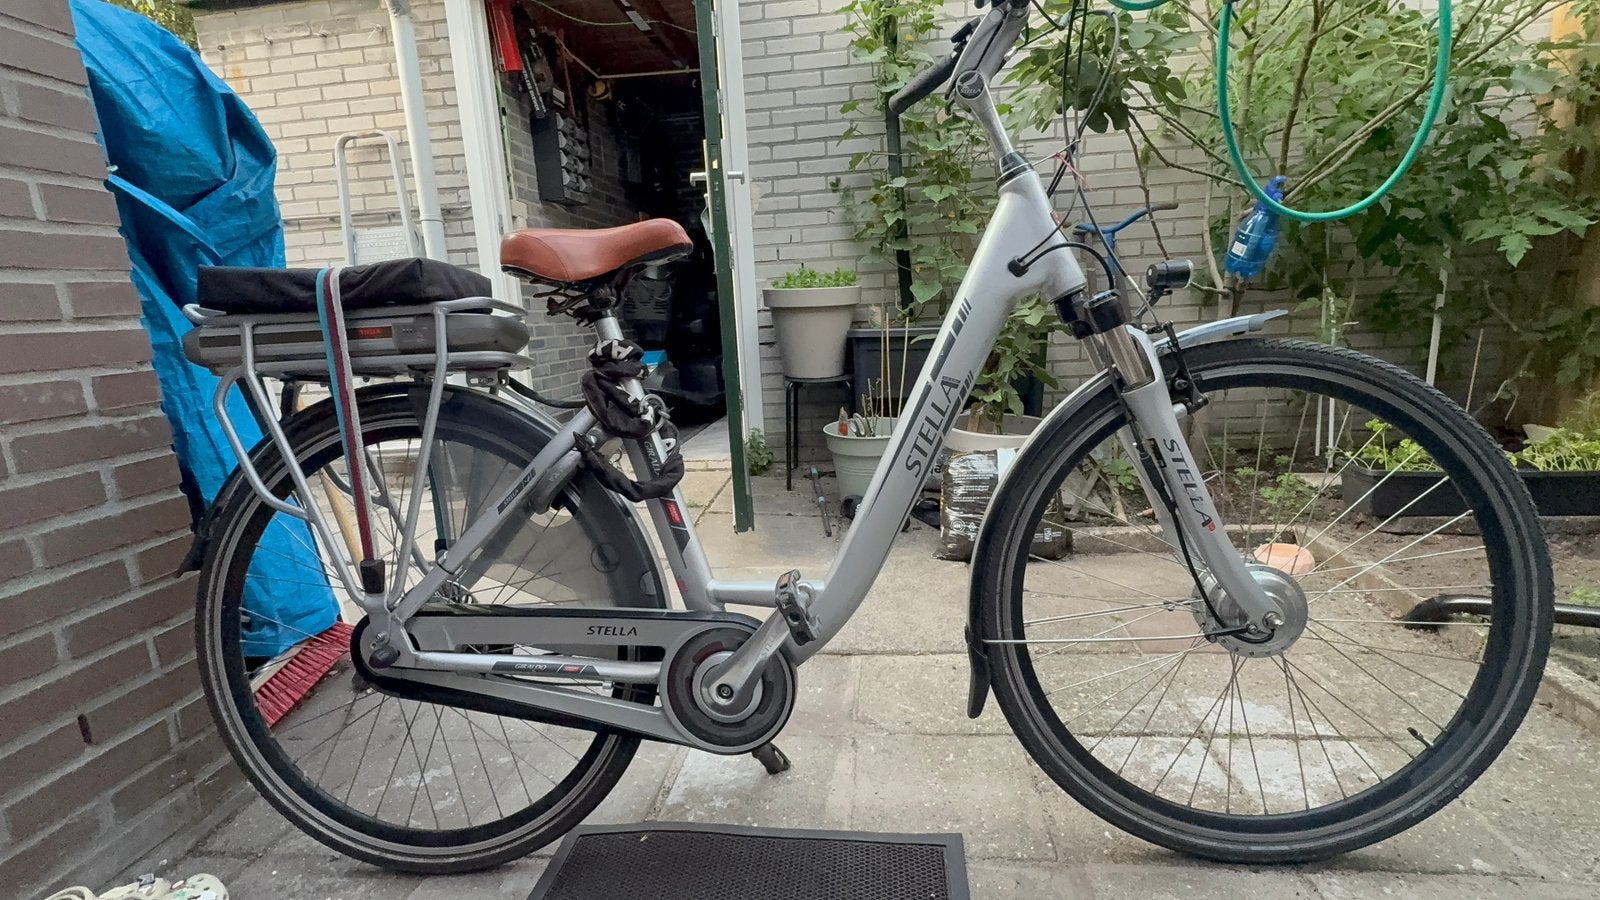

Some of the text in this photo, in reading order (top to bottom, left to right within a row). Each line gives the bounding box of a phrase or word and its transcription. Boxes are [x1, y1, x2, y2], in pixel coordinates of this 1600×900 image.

[905, 377, 959, 478] STELLA
[1163, 438, 1213, 527] STELLA
[586, 625, 638, 637] STELLA
